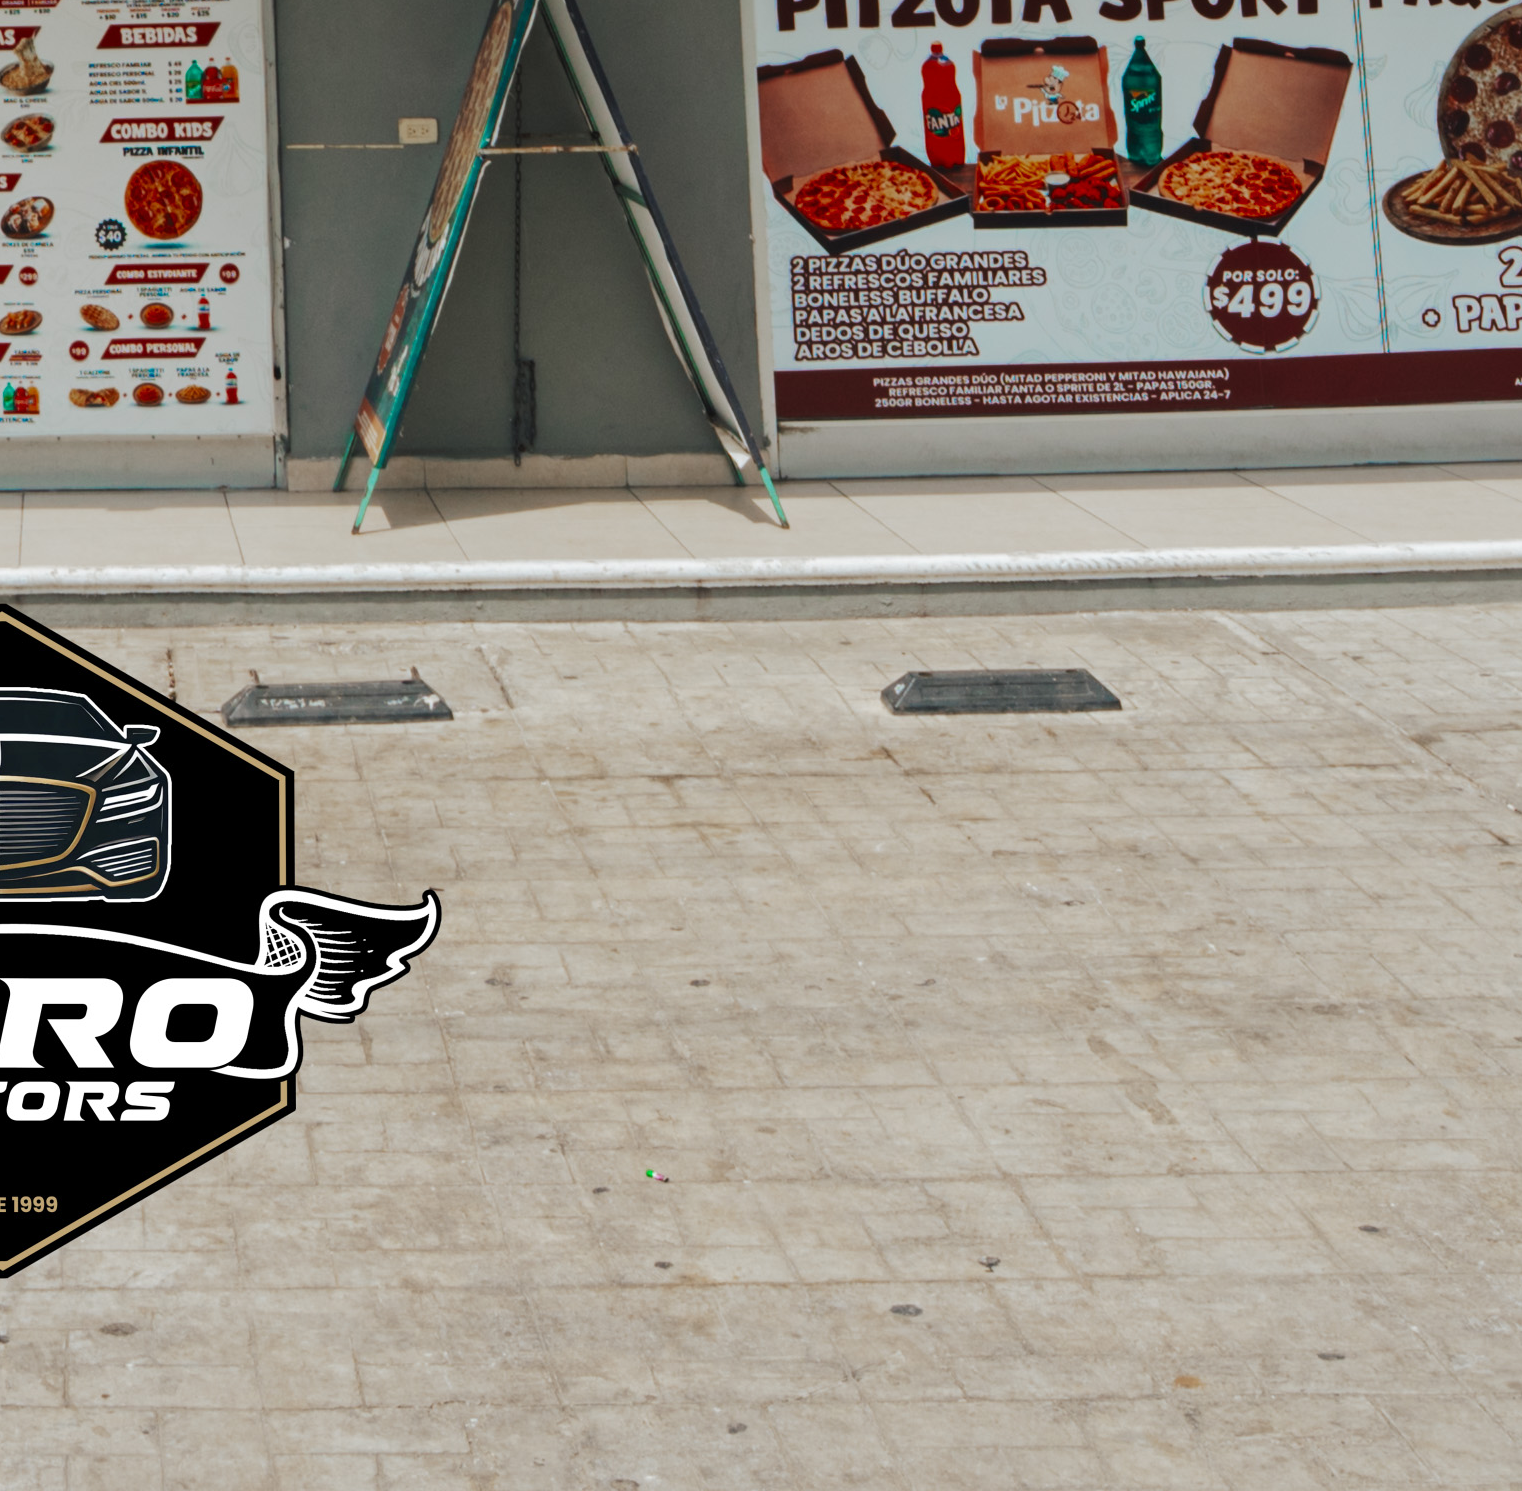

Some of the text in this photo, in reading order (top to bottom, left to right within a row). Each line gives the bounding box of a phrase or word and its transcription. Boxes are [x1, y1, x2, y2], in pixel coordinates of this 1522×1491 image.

[120, 26, 198, 45] BEBIDAS
[110, 121, 213, 140] COMBO KIDS
[791, 249, 1028, 274] 2 PIZZAS DÚO GRANDES
[792, 268, 1046, 292] 2 REFRESCOS FAMILIARES
[1222, 268, 1300, 283] POR SOLO:
[1212, 281, 1312, 318] $499
